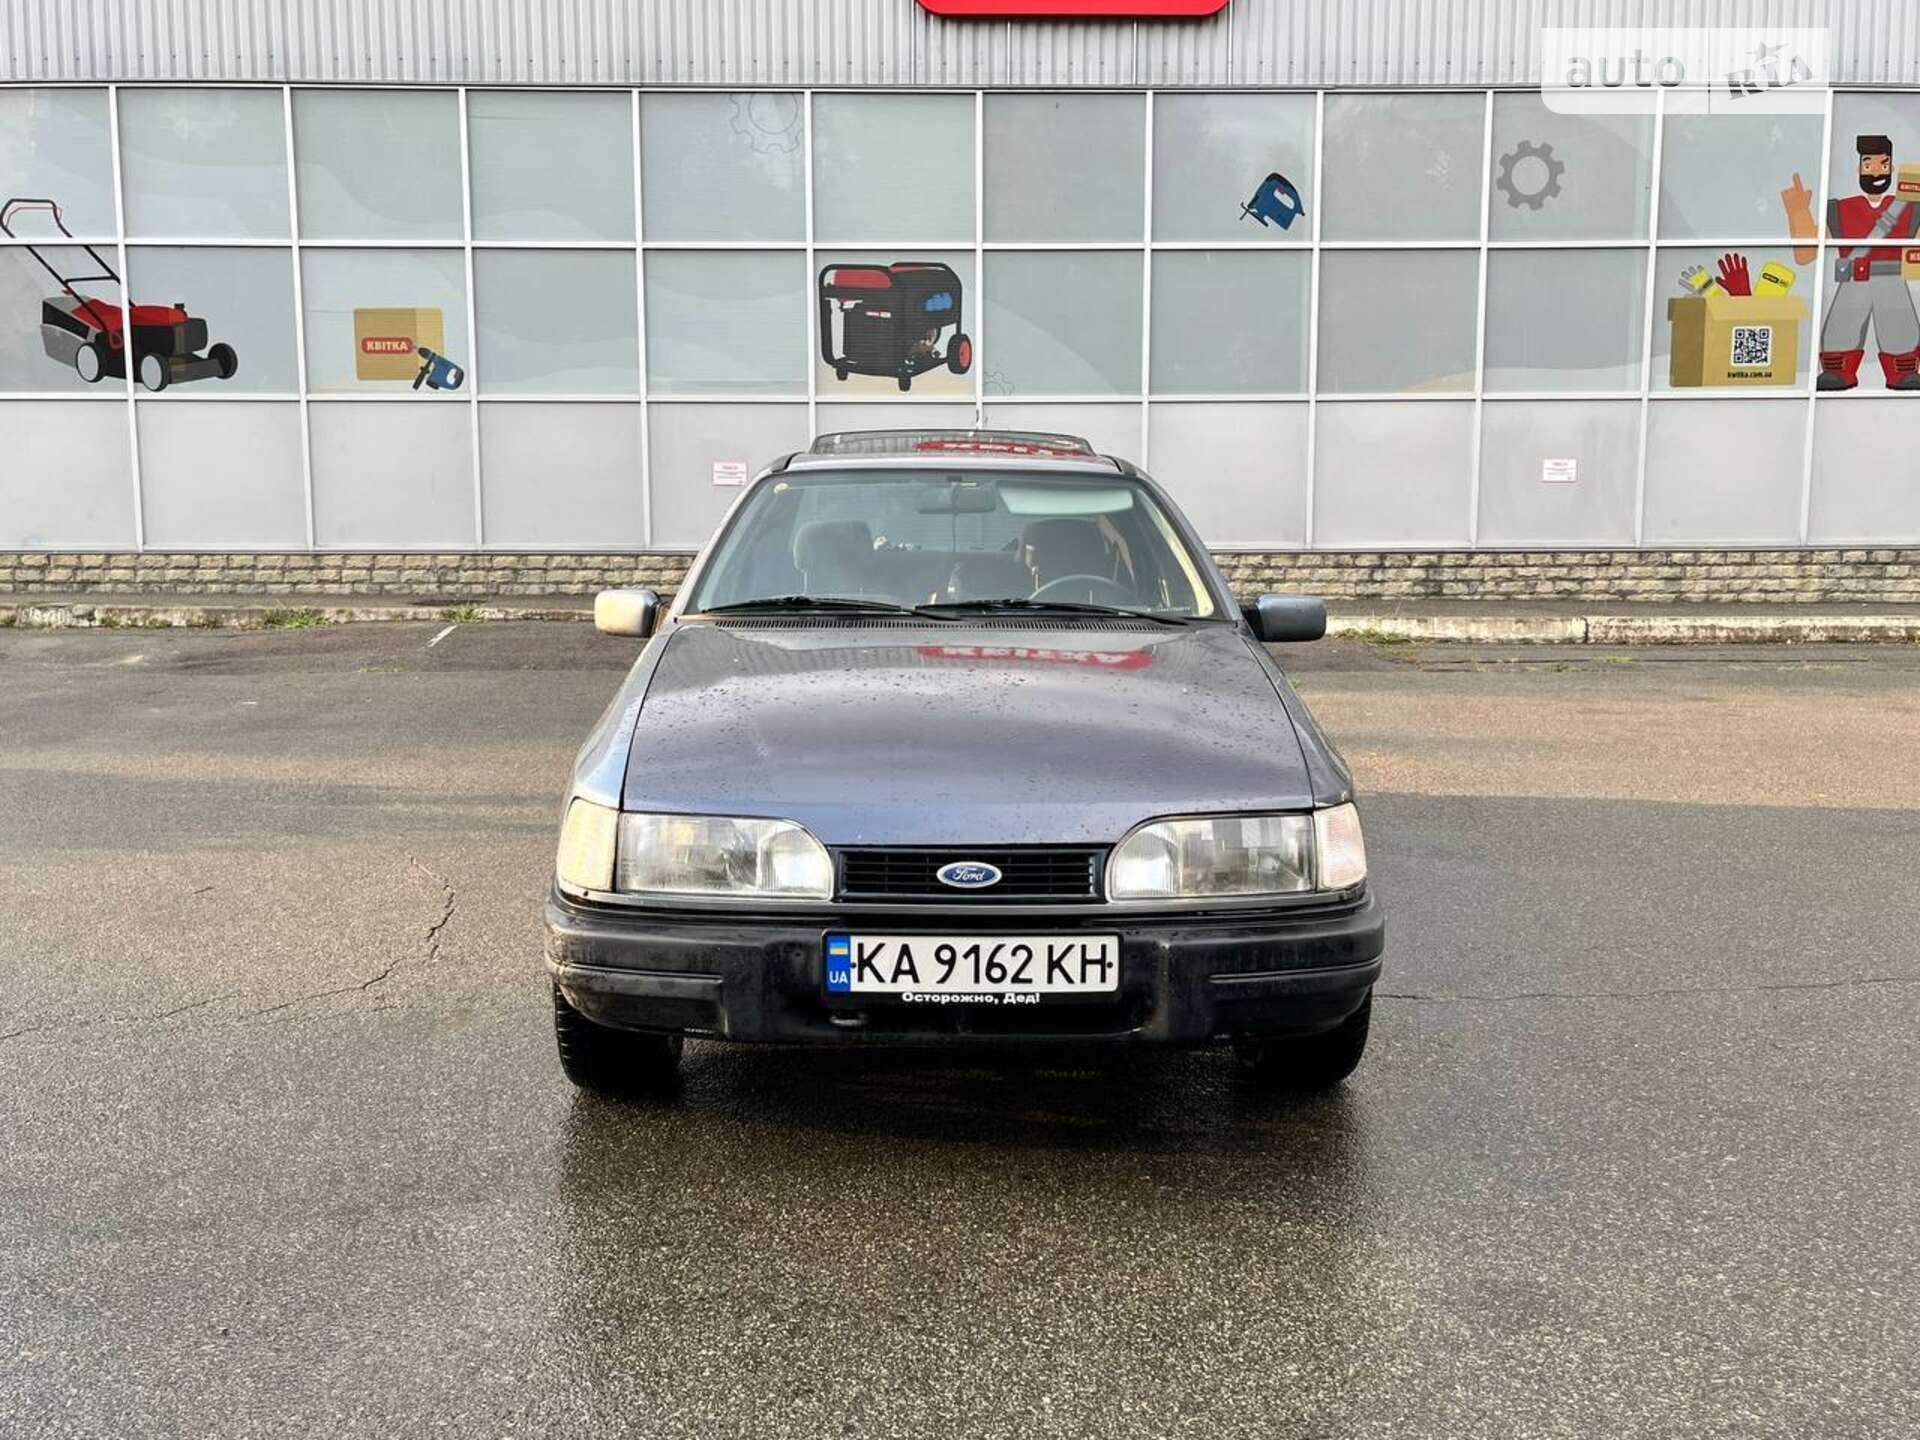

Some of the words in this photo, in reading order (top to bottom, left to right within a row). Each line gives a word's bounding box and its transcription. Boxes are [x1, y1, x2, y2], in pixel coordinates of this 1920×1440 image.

[366, 341, 409, 351] КВІТКА
[952, 867, 986, 881] Ford
[857, 943, 920, 983] KA
[934, 943, 1033, 984] 9162
[1046, 943, 1108, 984] KH
[829, 971, 848, 983] UA
[902, 992, 999, 1004] Осторожно,
[1003, 992, 1040, 1004] Дед!
